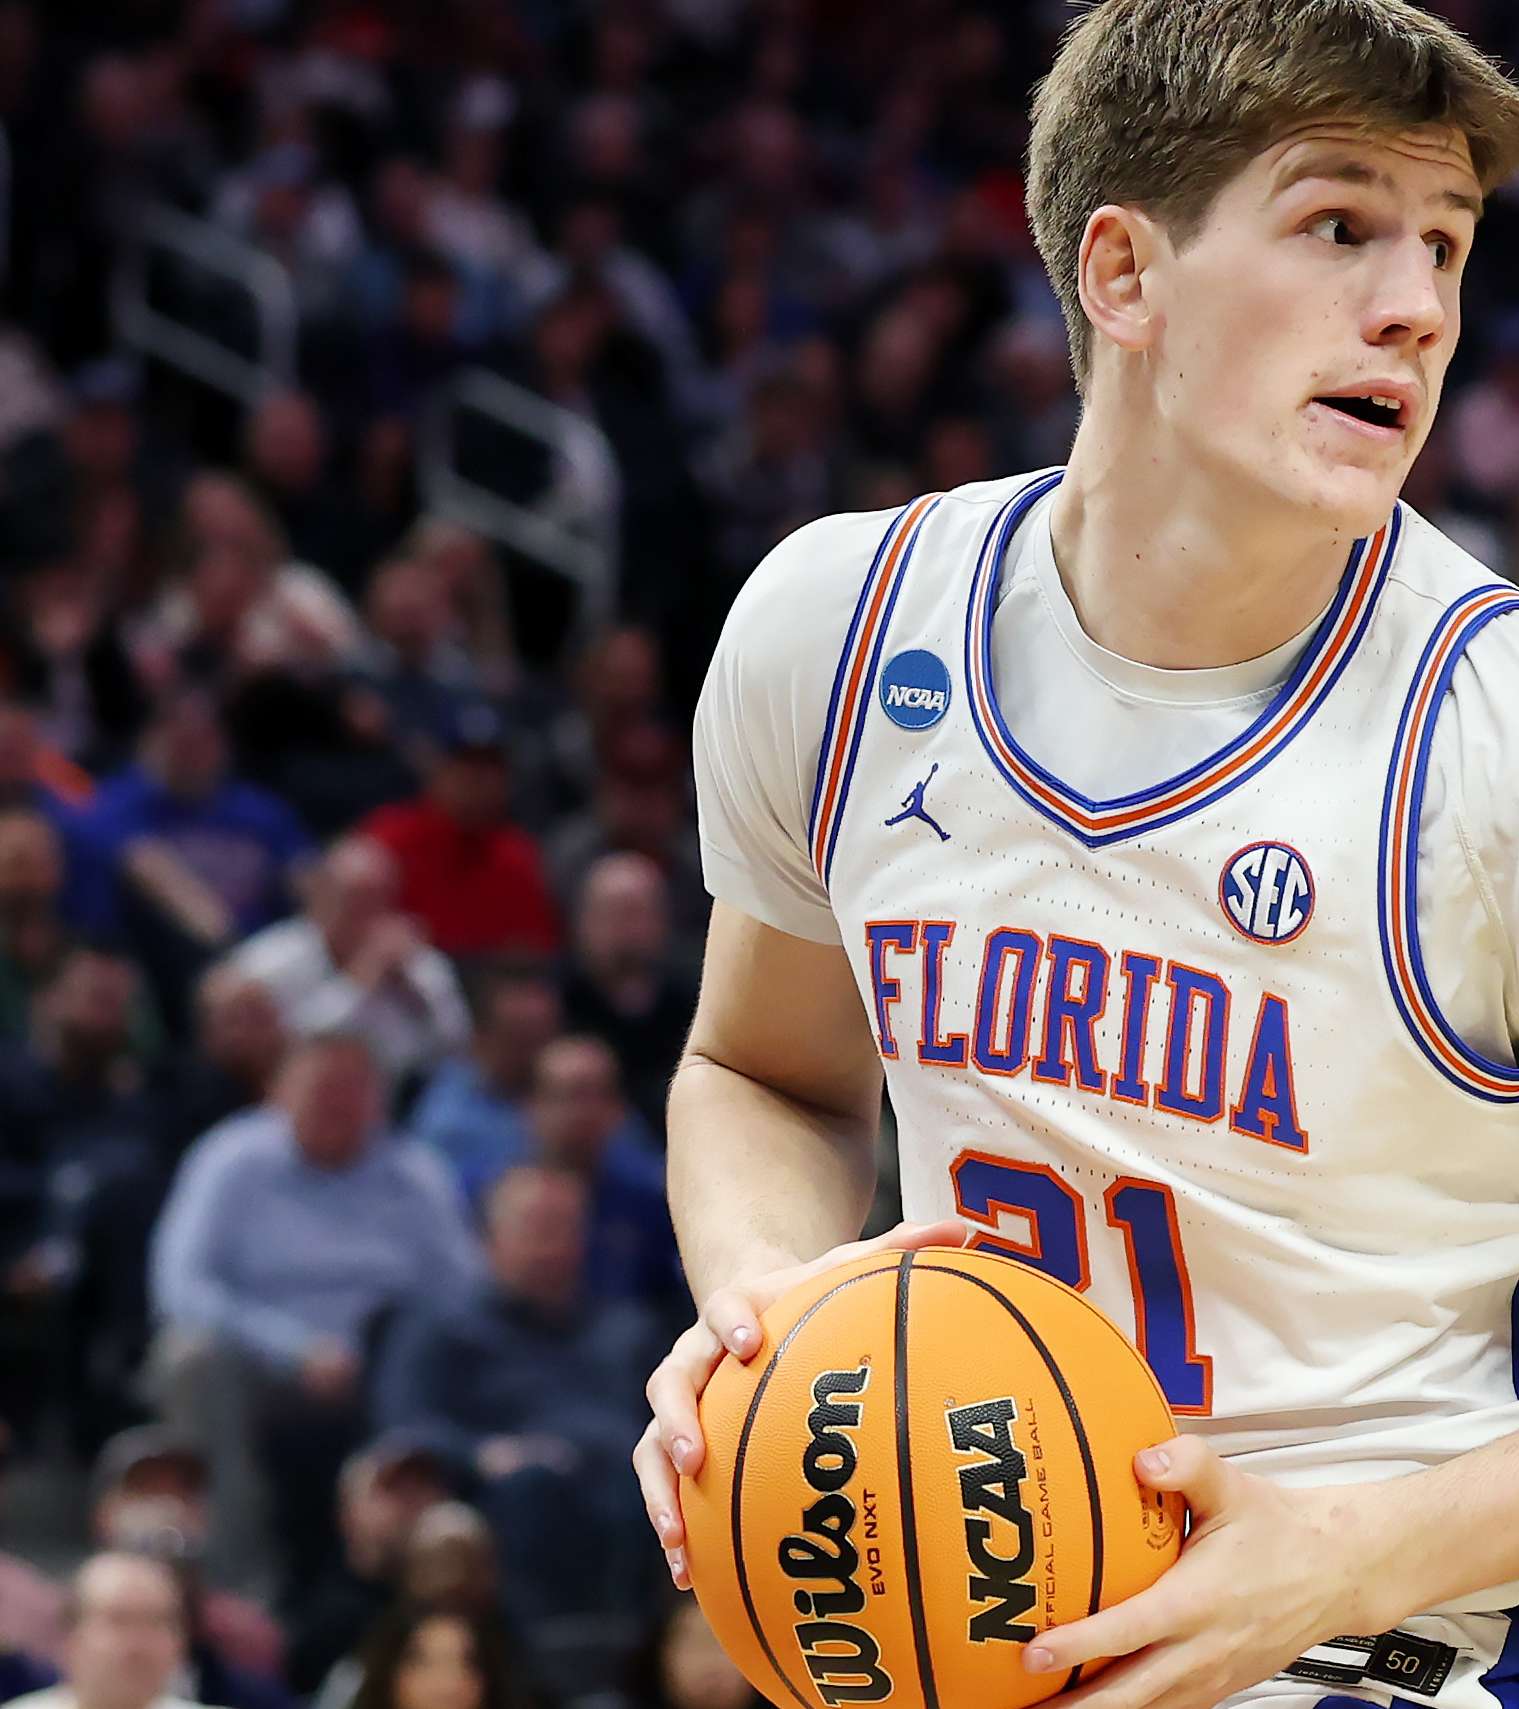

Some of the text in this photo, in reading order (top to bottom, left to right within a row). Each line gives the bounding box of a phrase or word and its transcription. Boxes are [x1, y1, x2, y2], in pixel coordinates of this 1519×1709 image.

[886, 684, 945, 712] NCAA
[1227, 846, 1309, 939] SEC
[864, 920, 1309, 1155] FLORIDA
[778, 1365, 894, 1708] Wilson
[863, 1488, 886, 1597] EVO NXT
[945, 1396, 1039, 1644] NCAA
[1025, 1397, 1056, 1631] FFICIAL GAME BALL
[1385, 1649, 1420, 1675] 50
